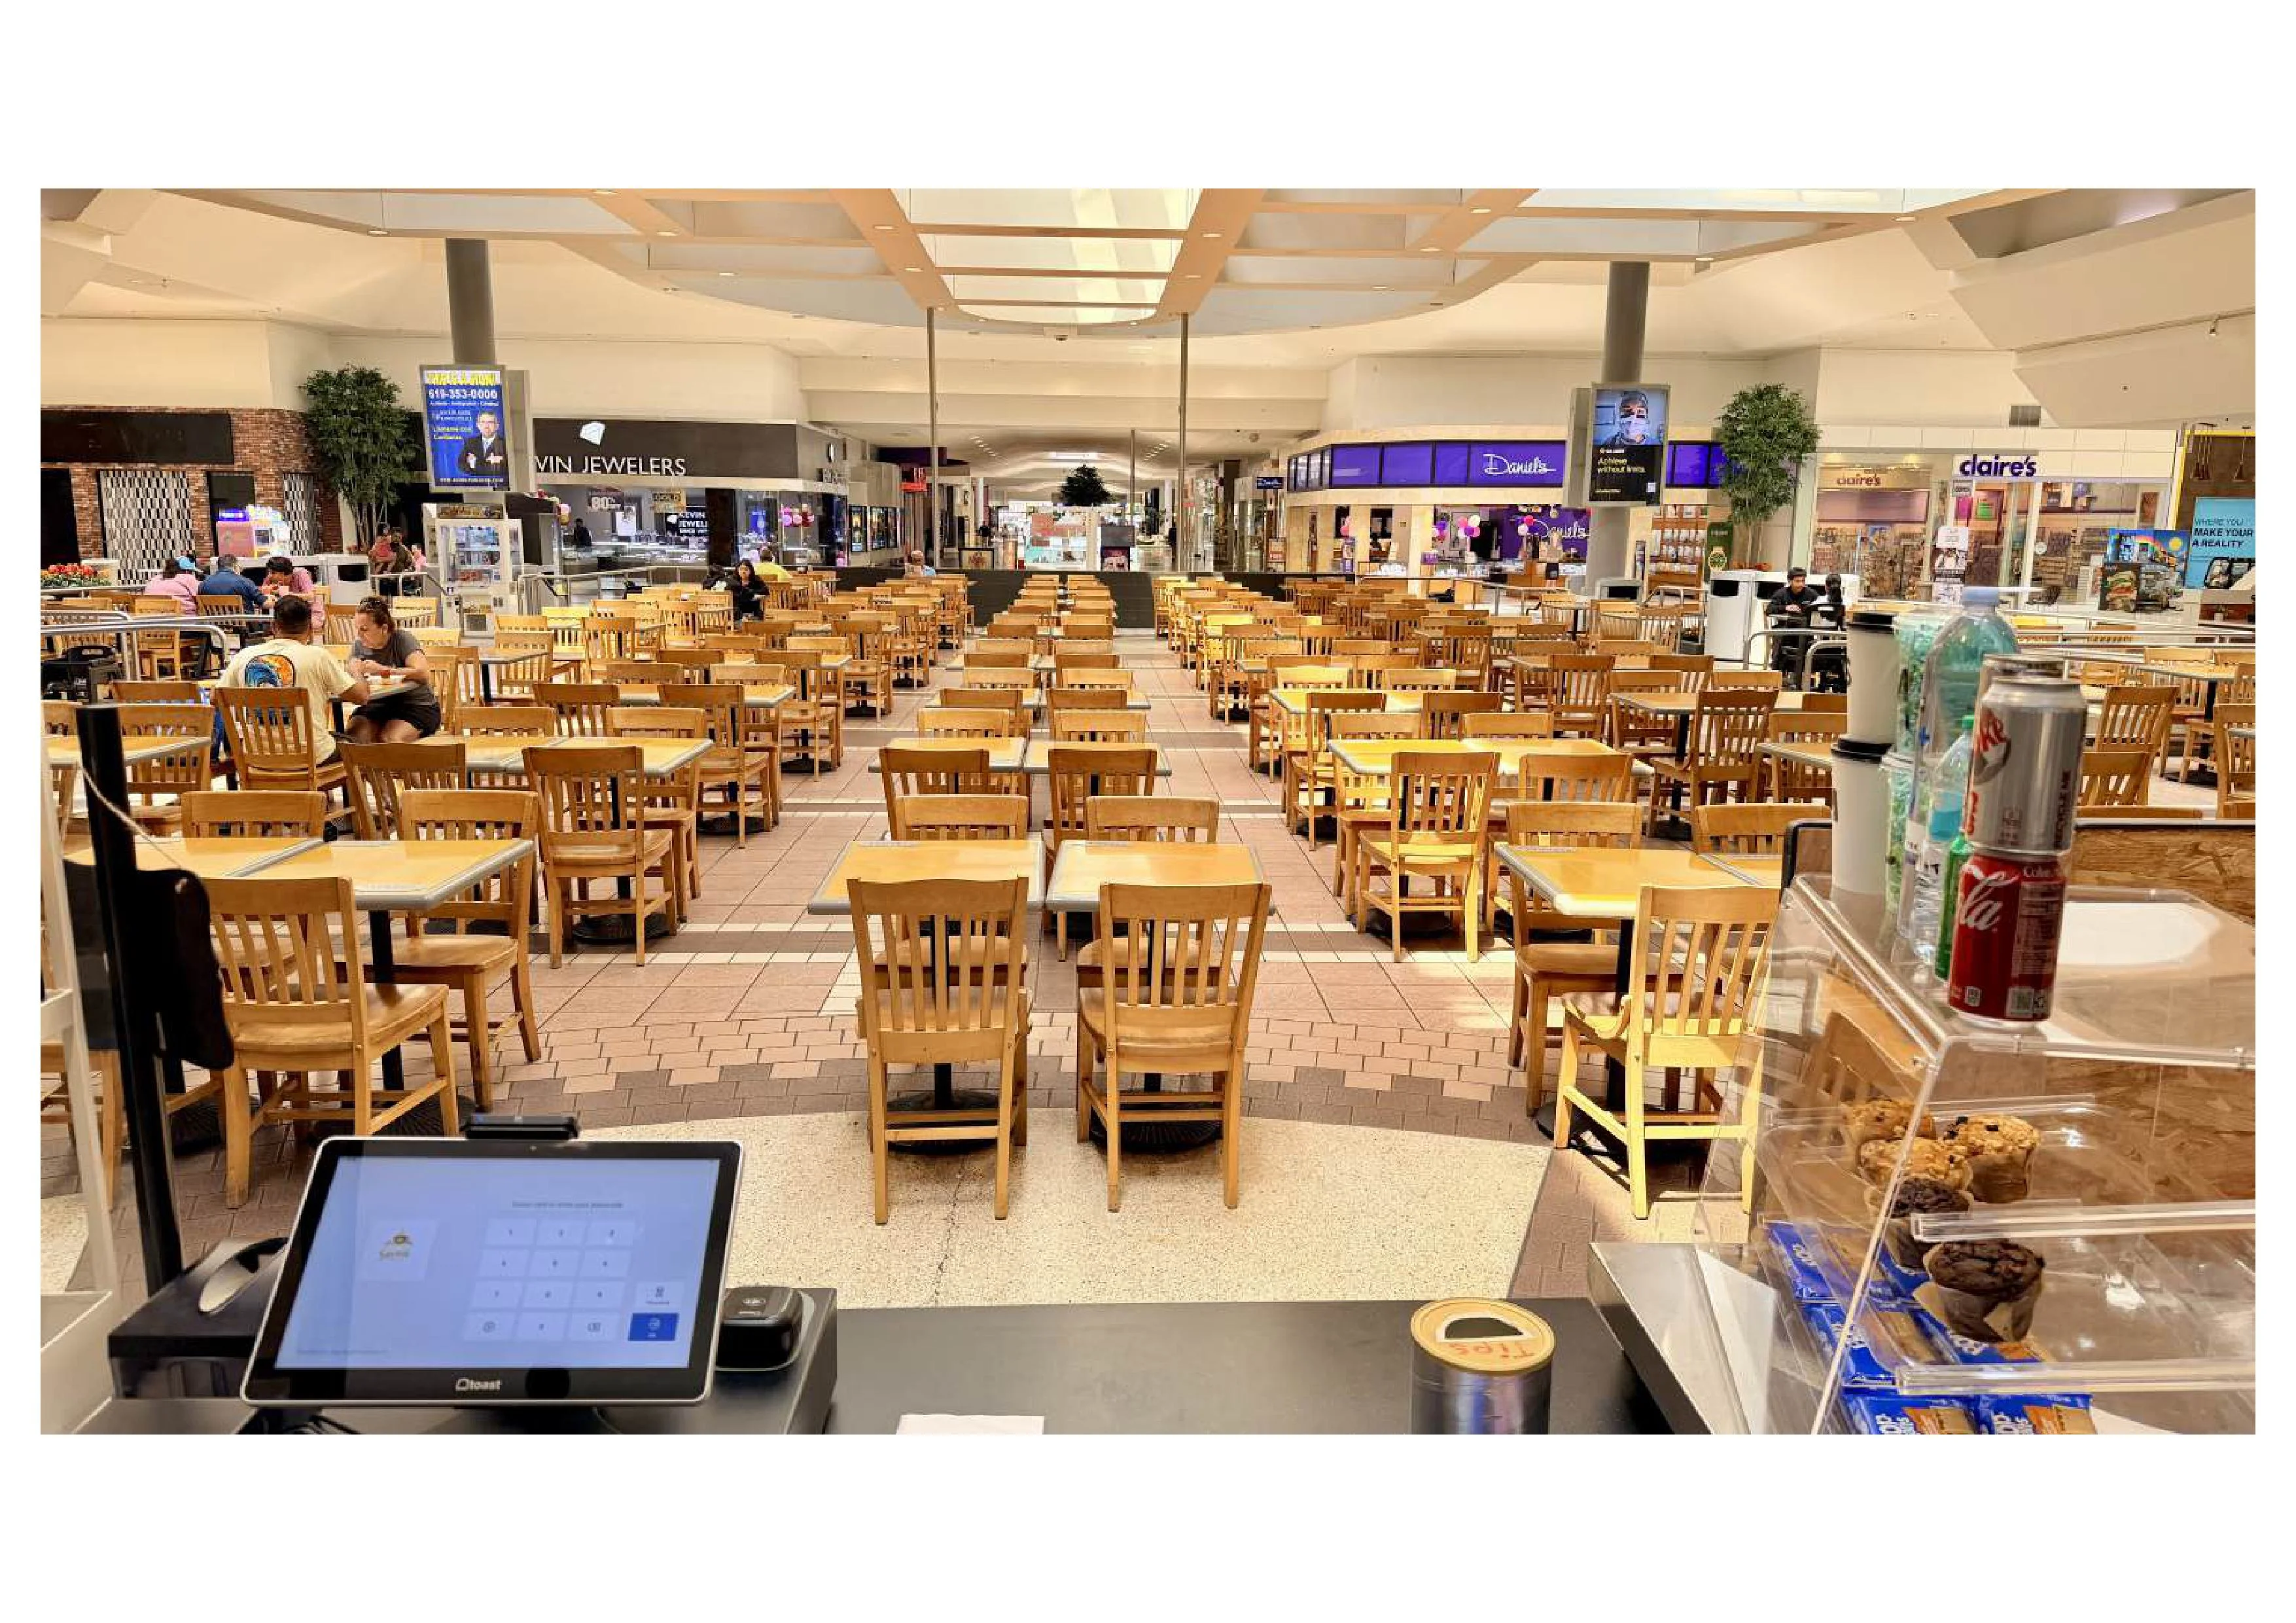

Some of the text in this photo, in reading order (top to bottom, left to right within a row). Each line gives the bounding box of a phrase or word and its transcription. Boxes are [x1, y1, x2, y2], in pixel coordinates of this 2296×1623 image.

[582, 455, 687, 477] JEWELERS
[1483, 454, 1557, 474] Daniel's
[1958, 454, 2037, 476] claire's
[2194, 528, 2254, 537] MAKE YOUR
[2201, 539, 2244, 547] REALITY
[1449, 1342, 1535, 1360] Tips
[468, 1380, 502, 1391] toast
